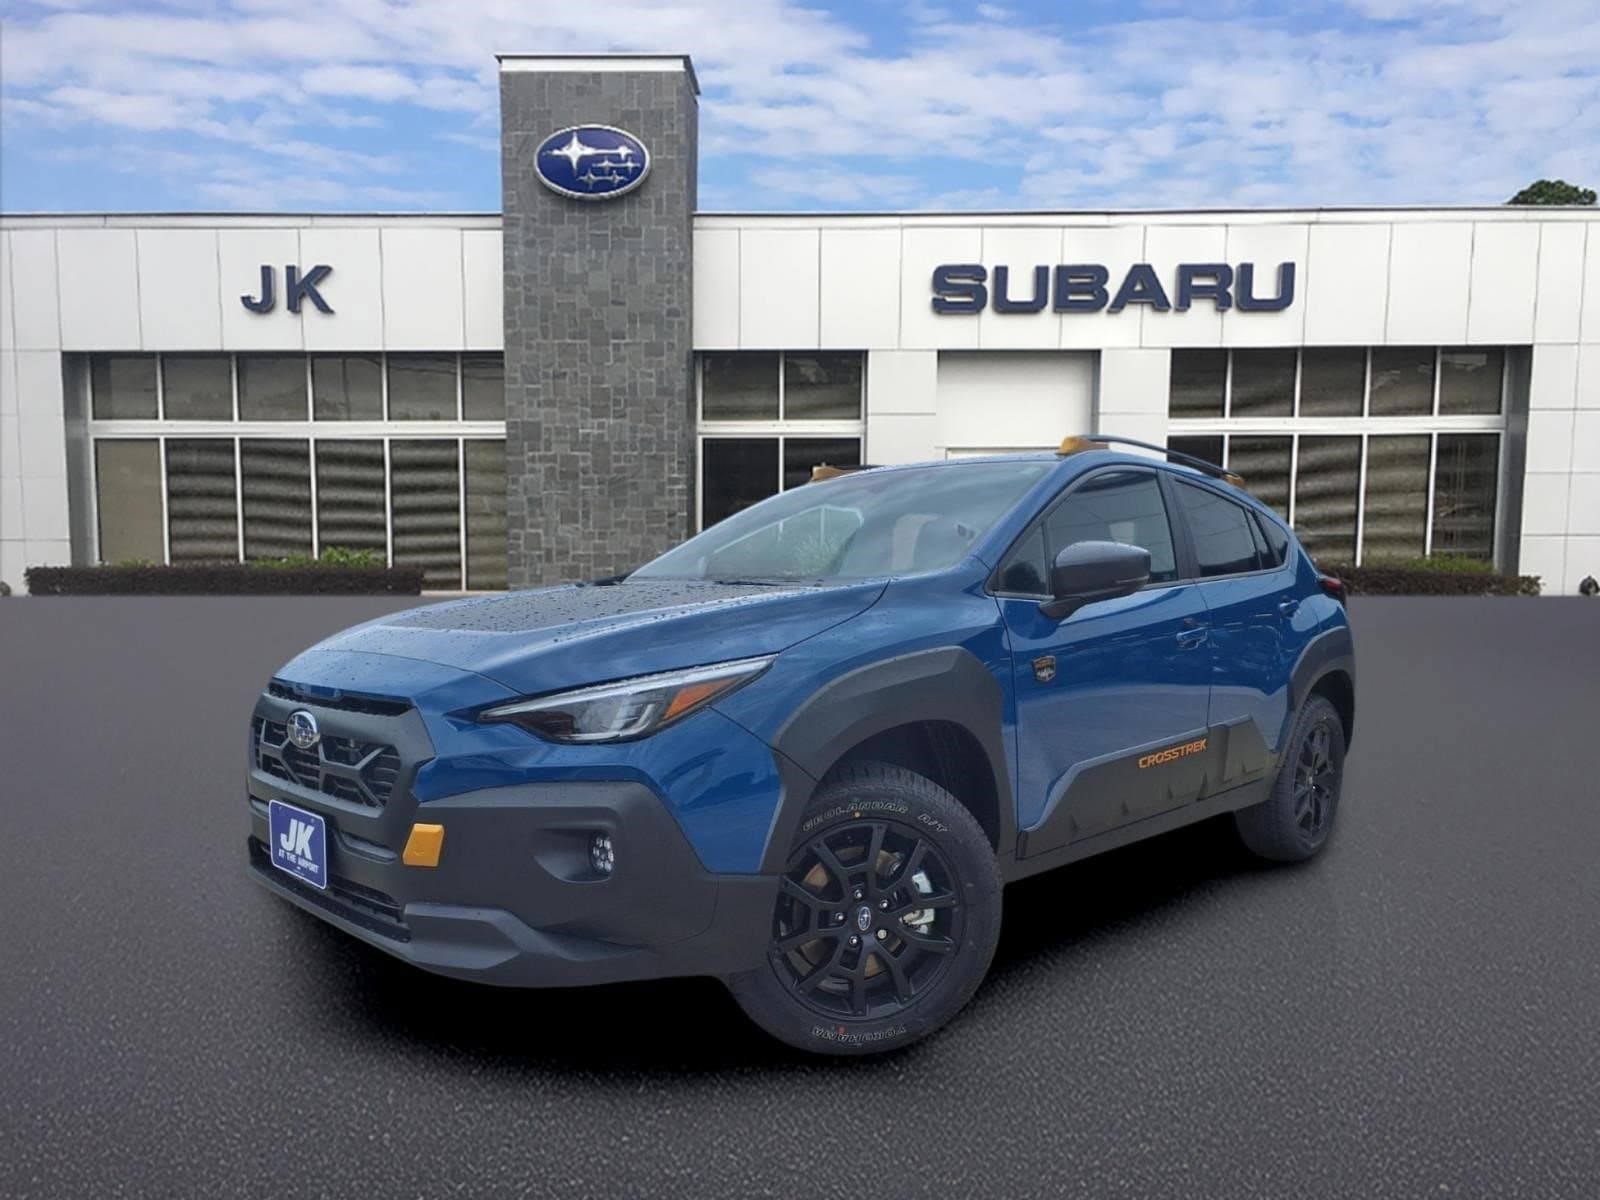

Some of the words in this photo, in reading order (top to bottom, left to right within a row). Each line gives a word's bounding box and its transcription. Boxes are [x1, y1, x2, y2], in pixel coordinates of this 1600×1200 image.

[240, 265, 335, 314] JK
[931, 262, 1296, 314] SUBARU
[1138, 738, 1207, 769] CROSSTREK
[280, 818, 315, 861] JK
